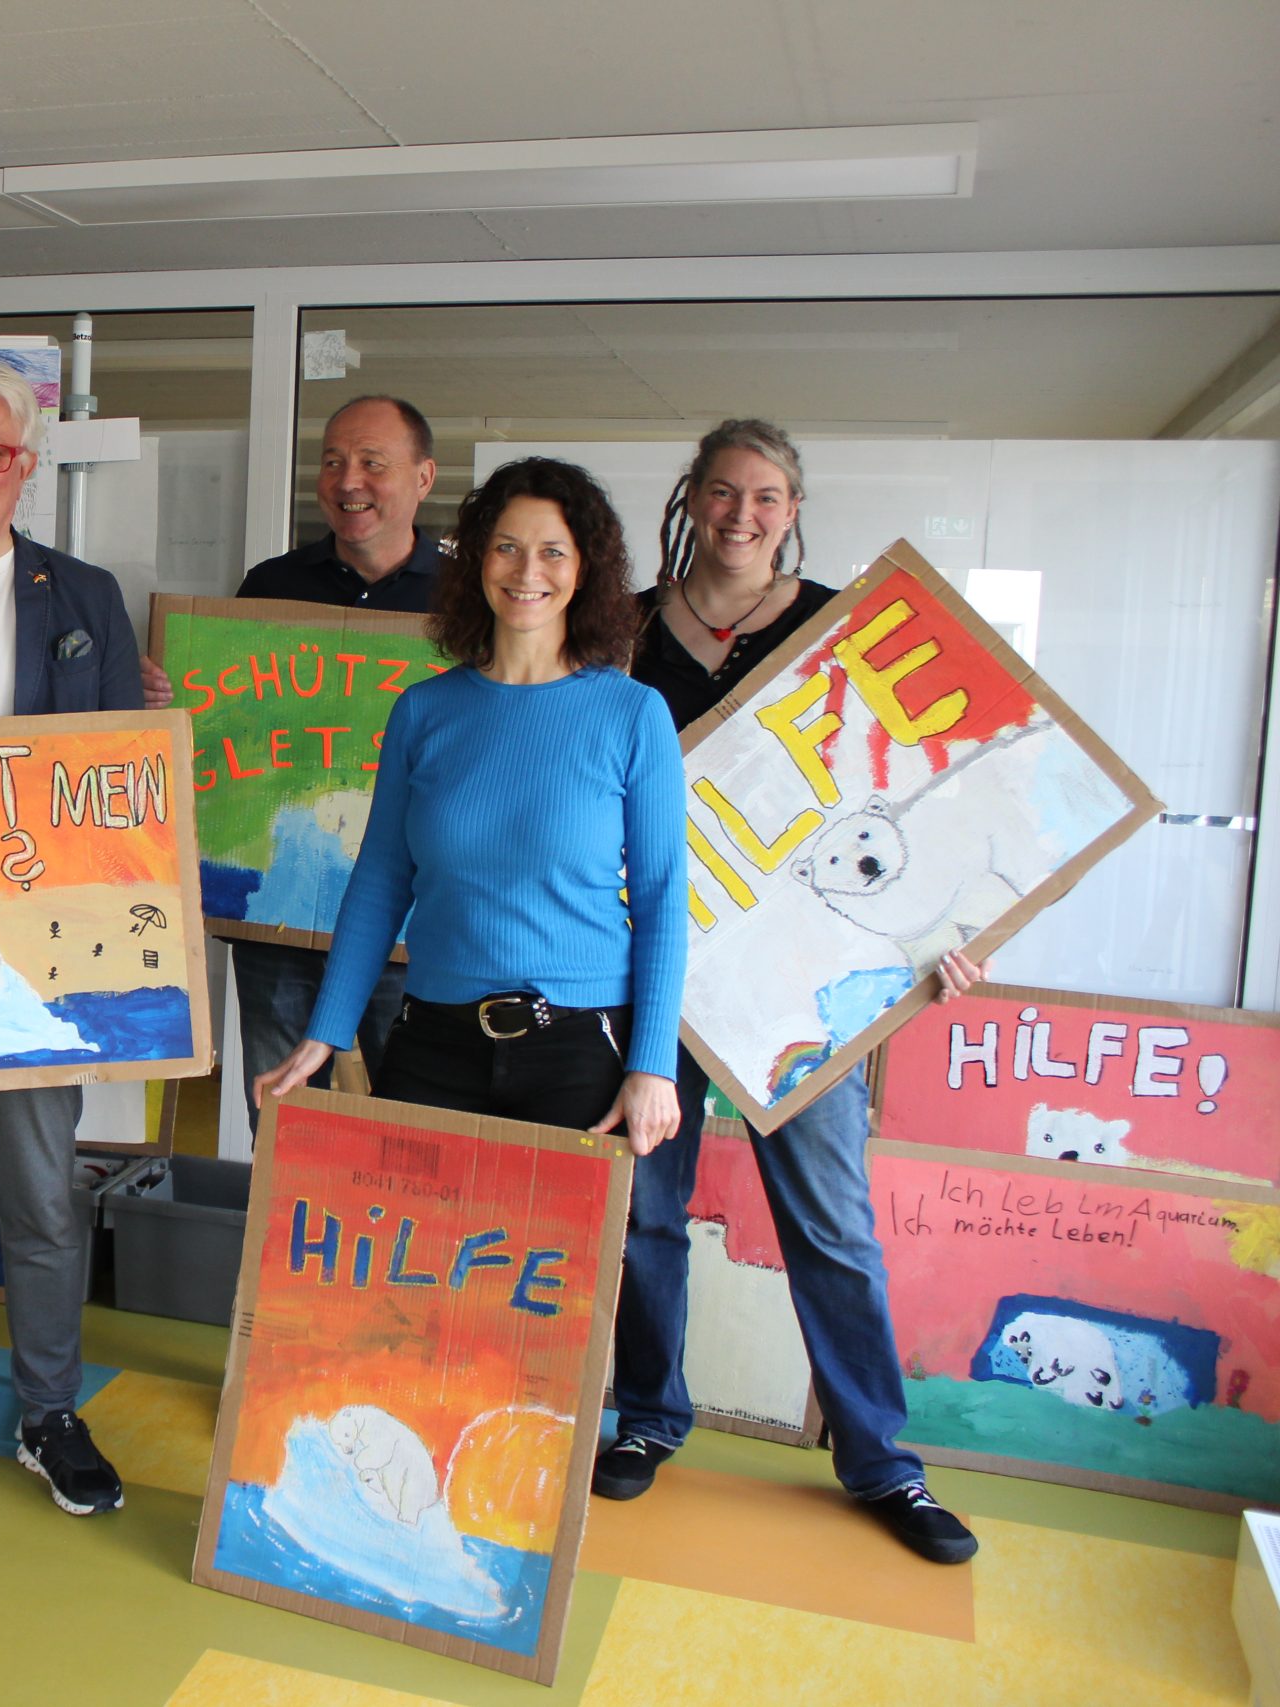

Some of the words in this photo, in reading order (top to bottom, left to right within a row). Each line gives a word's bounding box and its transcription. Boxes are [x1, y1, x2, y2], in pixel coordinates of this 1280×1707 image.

[51, 752, 168, 830] MEIN
[687, 597, 970, 933] ILFE
[890, 1192, 932, 1236] Ich
[954, 1217, 1038, 1237] möchte
[940, 1170, 984, 1208] Ich
